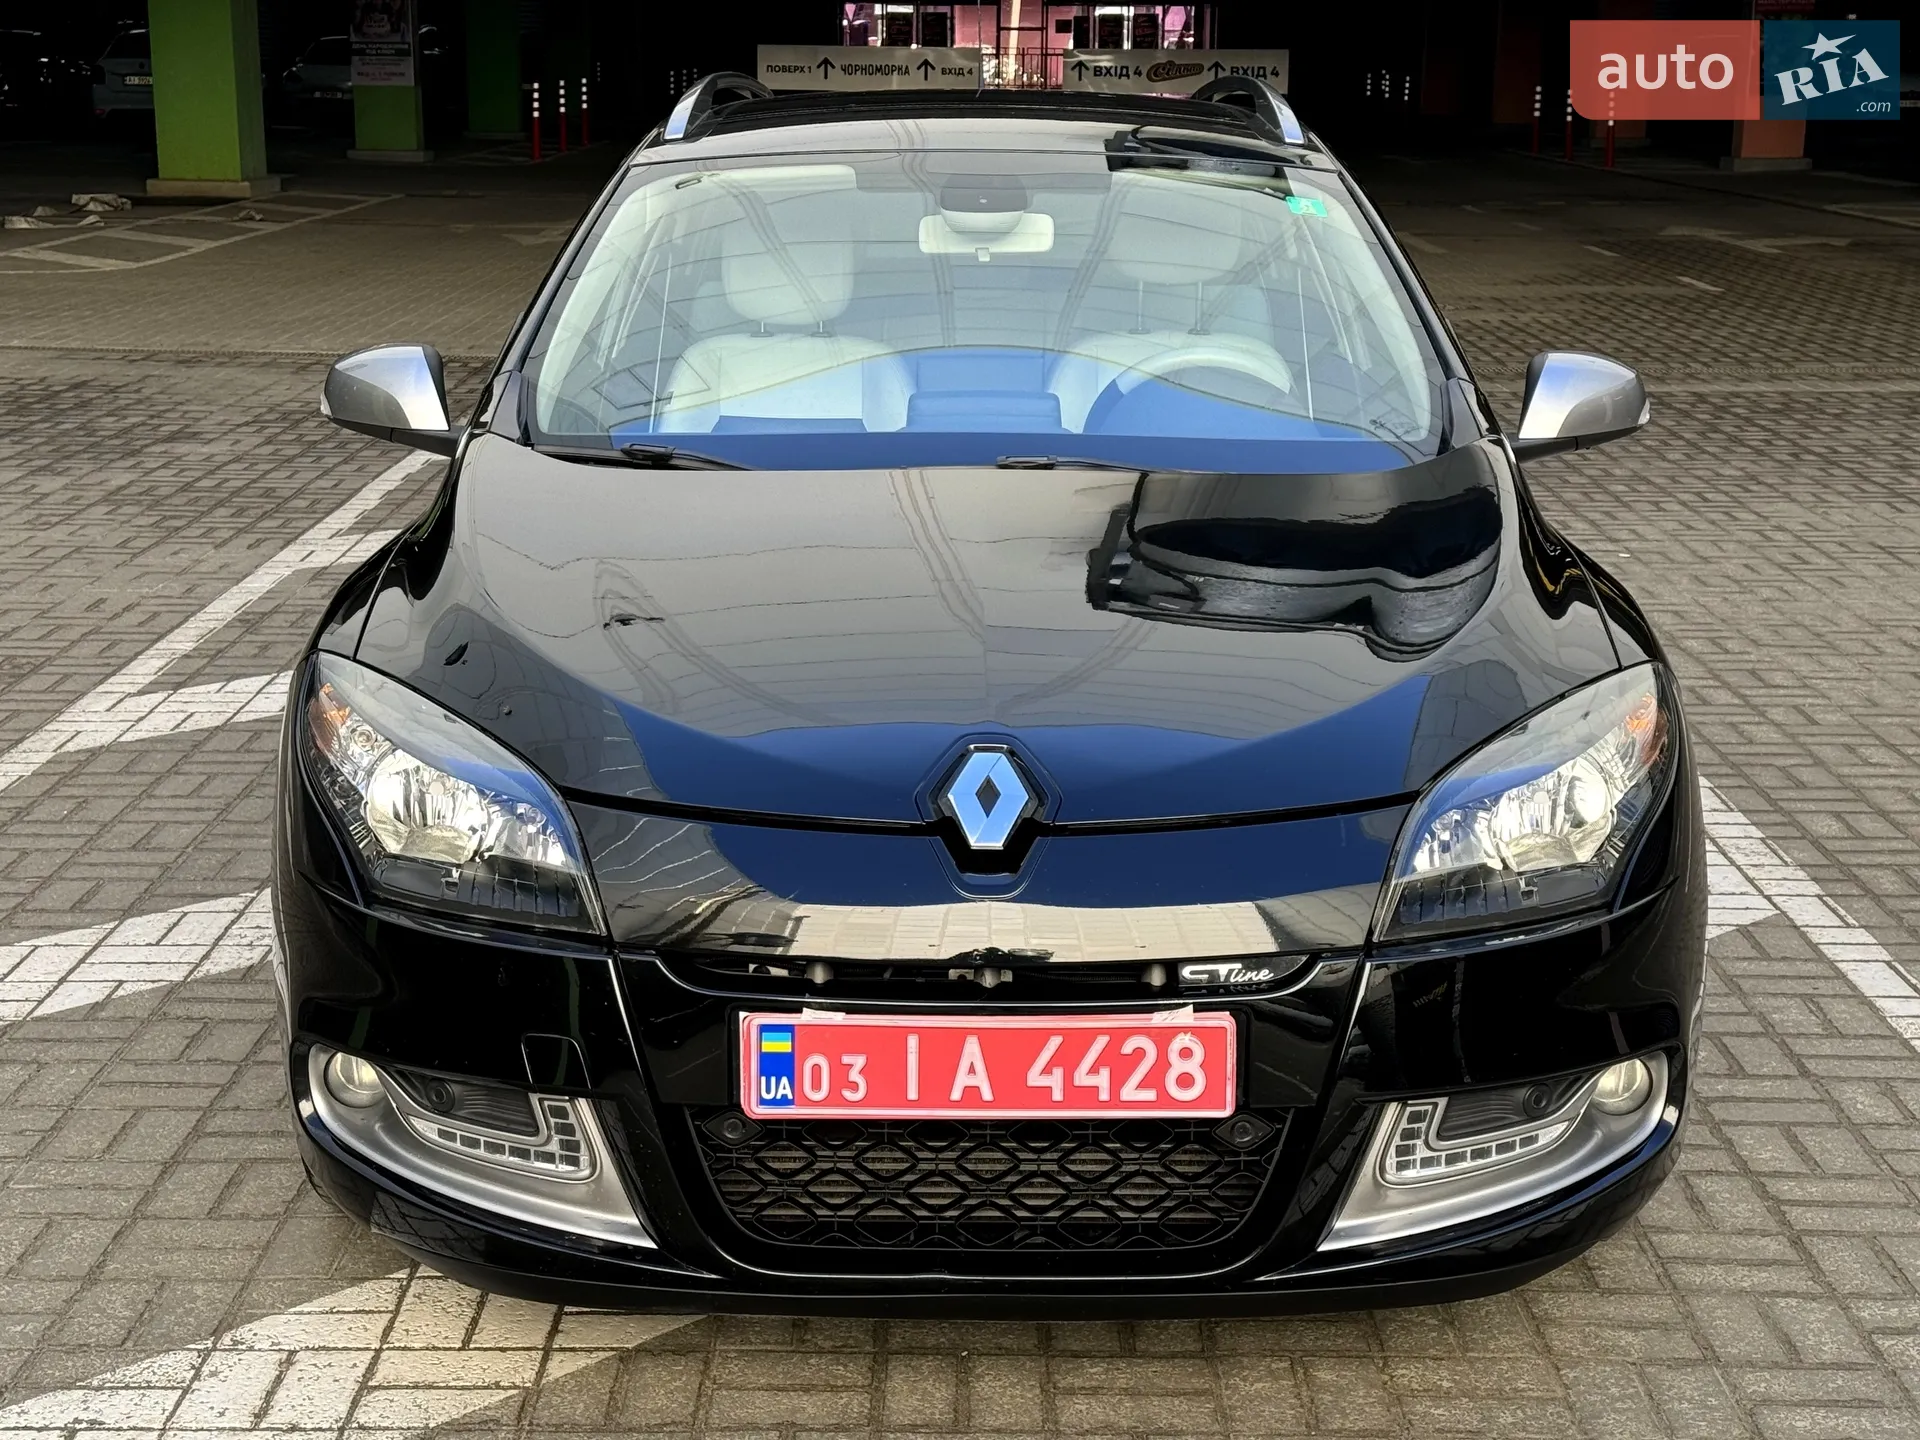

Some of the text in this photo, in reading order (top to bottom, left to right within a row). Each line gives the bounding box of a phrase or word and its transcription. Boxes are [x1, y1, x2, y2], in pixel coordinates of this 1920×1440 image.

[766, 64, 806, 74] ПОВЕРХ
[840, 63, 911, 76] ЧОРНОМОРКА
[941, 67, 974, 77] ВХІД 4
[1093, 65, 1143, 79] ВХІД 4
[1270, 66, 1280, 78] 4
[802, 1053, 868, 1102] 03
[1025, 1031, 1208, 1102] 4428
[760, 1075, 793, 1100] UA
